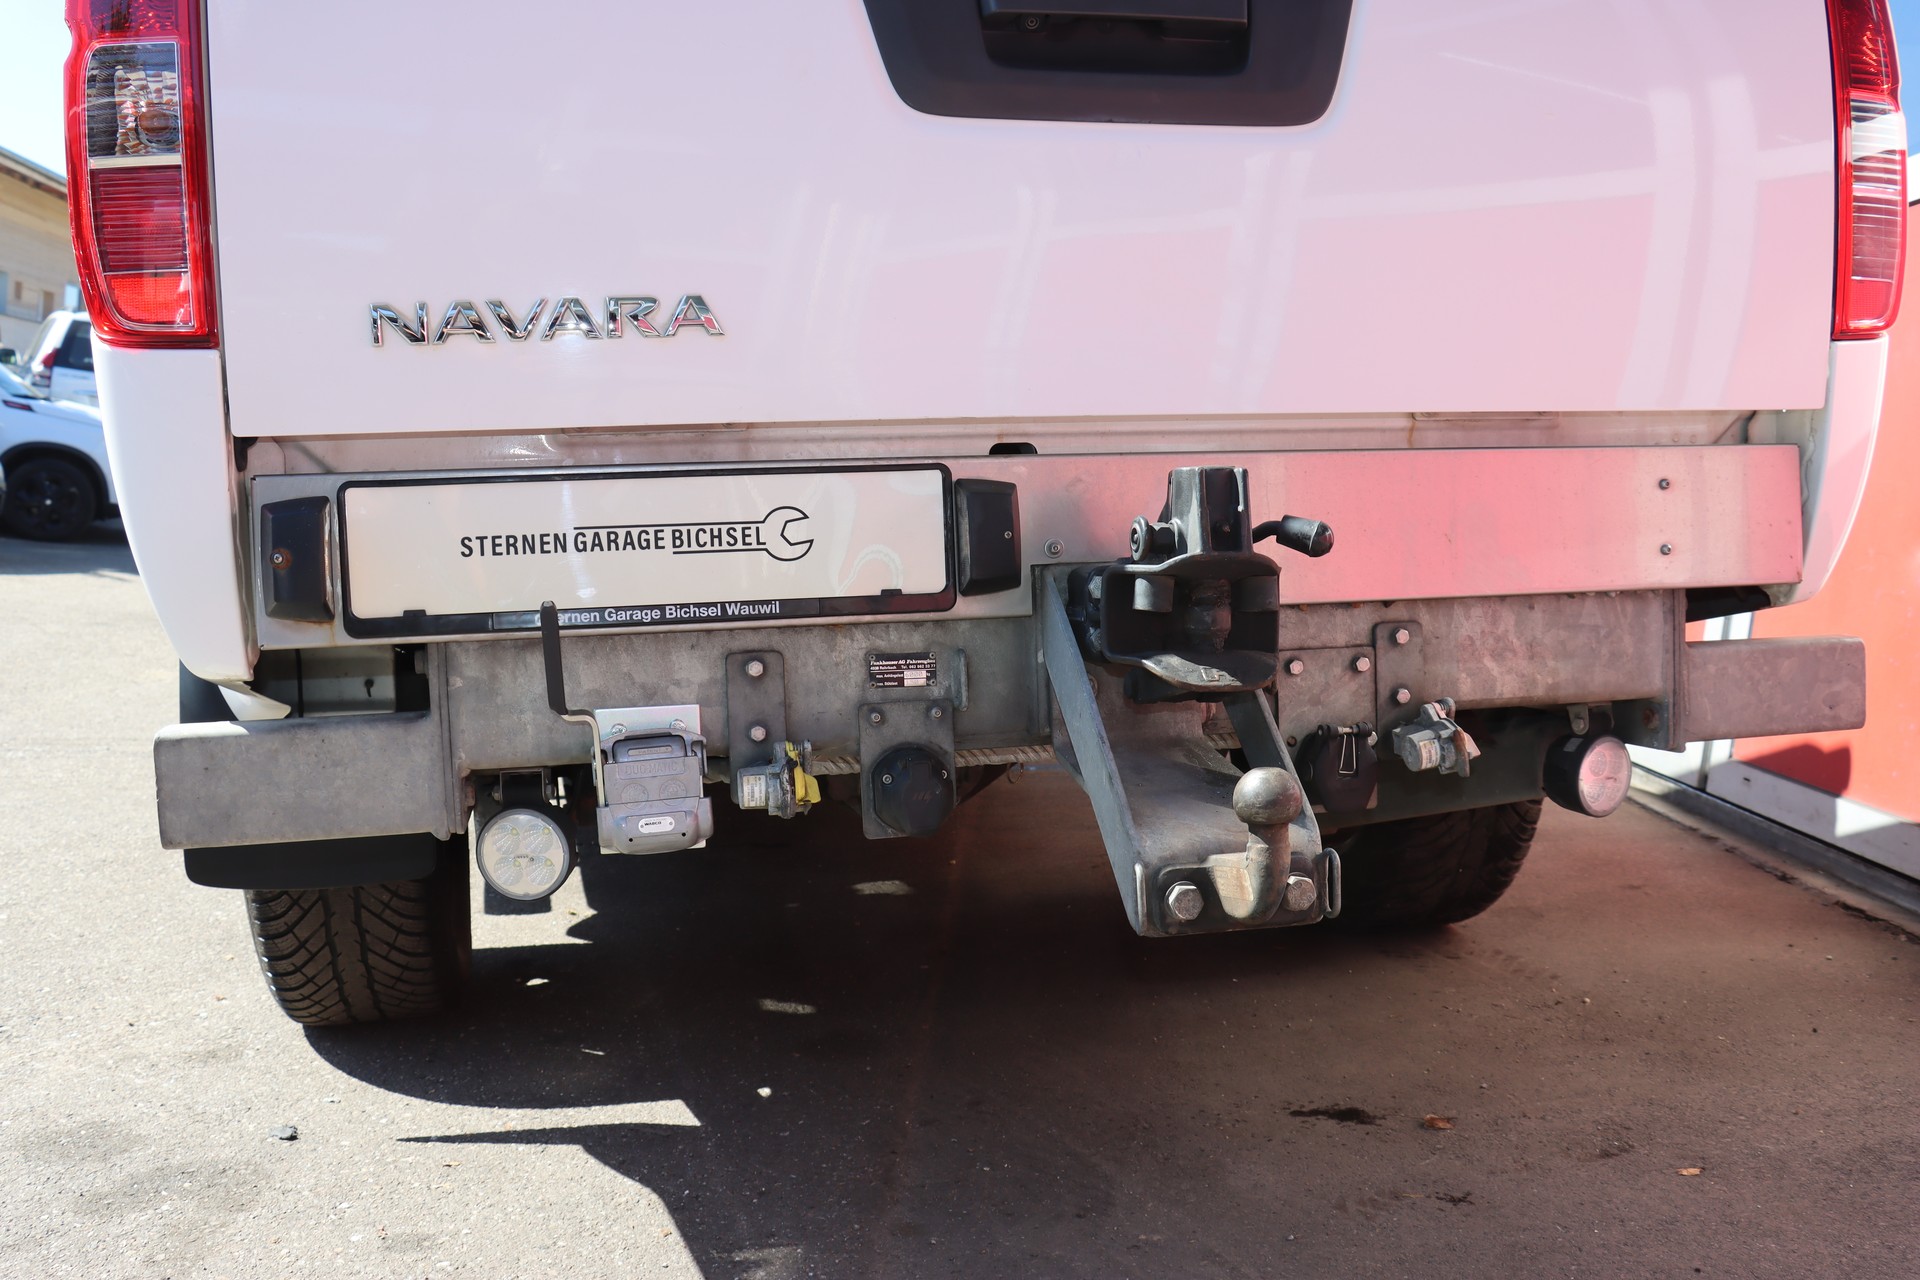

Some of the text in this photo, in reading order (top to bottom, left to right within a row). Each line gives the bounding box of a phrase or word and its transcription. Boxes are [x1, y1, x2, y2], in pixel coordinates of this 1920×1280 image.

[370, 295, 725, 346] NAVARA
[460, 526, 766, 557] STERNEN GARAGE BICHSEL
[534, 600, 780, 626] ernen Garage Bichsel Wauwil
